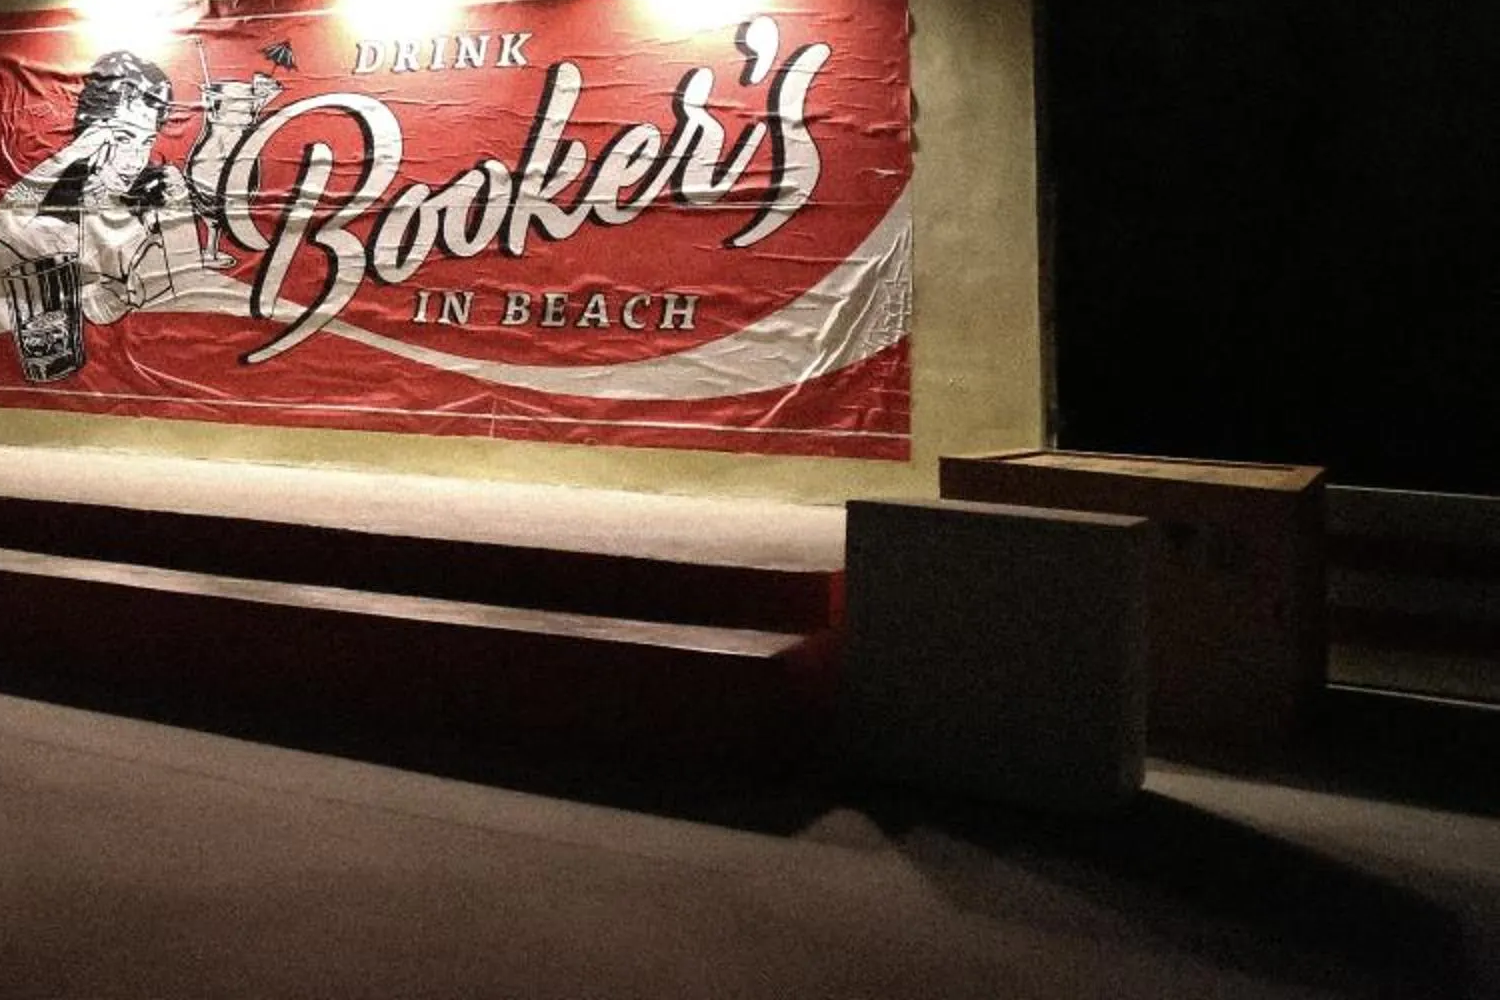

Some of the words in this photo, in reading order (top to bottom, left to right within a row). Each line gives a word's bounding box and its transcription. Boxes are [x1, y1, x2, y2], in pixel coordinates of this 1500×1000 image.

[355, 32, 533, 76] DRINK
[222, 16, 830, 362] Booker's
[413, 289, 473, 325] IN
[503, 292, 698, 331] BEACH
